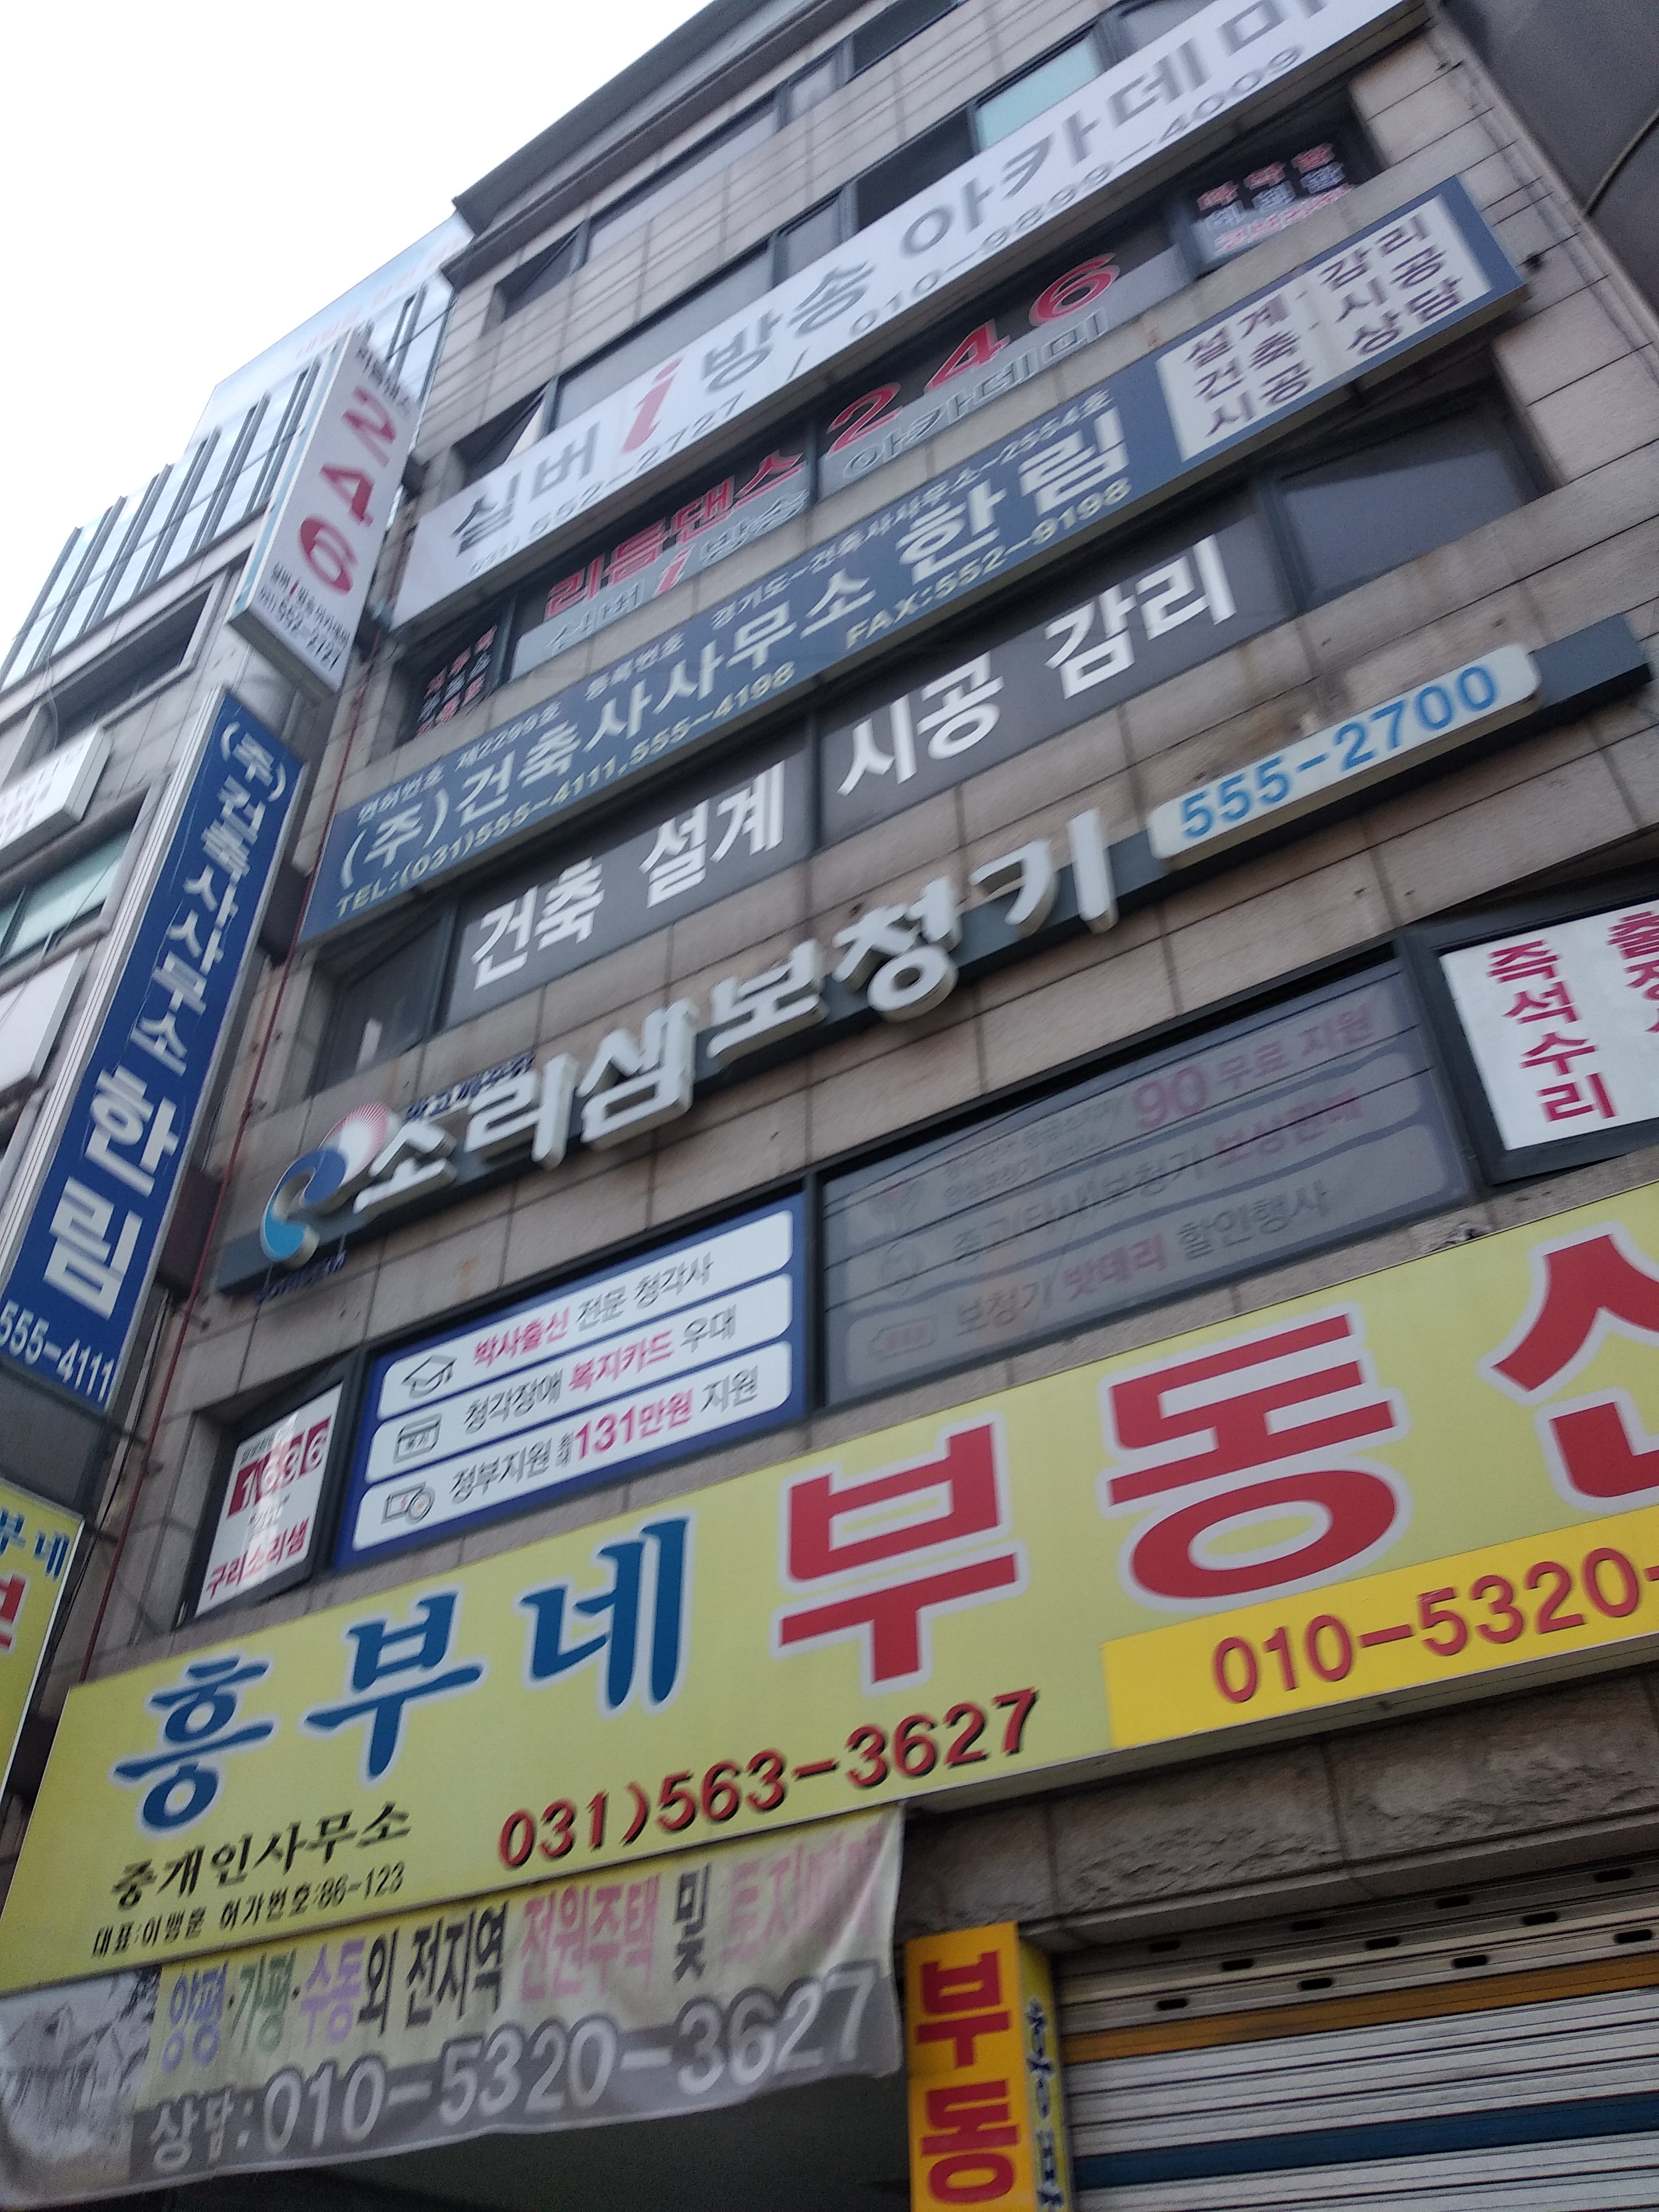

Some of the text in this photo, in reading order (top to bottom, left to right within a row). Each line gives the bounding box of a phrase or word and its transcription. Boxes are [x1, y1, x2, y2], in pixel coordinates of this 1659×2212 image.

[826, 251, 1121, 457] 246
[1206, 276, 1464, 437] 시공 상담
[299, 385, 397, 594] 246
[340, 568, 877, 889] (주)건축사사무소
[896, 406, 1130, 585] 한림
[472, 534, 1239, 990] 건축 설계 시공 감리
[353, 664, 1500, 1214] 소리샘보청기 555-2700
[1218, 1044, 1291, 1089] 무료
[1301, 1001, 1374, 1057] 지원
[1486, 938, 1619, 1123] 즉석수리
[42, 1065, 179, 1320] 한림
[1177, 1180, 1331, 1261] 할인행사
[0, 1299, 114, 1403] 555-4111
[464, 1305, 738, 1433] 청각장애 복지카드 우대
[472, 1251, 713, 1369] 박사출신 전문 청각사
[449, 1438, 552, 1504] 정부지원
[574, 1389, 693, 1461] 131만원
[700, 1364, 760, 1414] 지원
[113, 1517, 693, 1830] 흥부네
[112, 1801, 411, 1910] 중개인사무소
[497, 1687, 1040, 1869] 031)563-3627
[673, 1862, 712, 1983] 및
